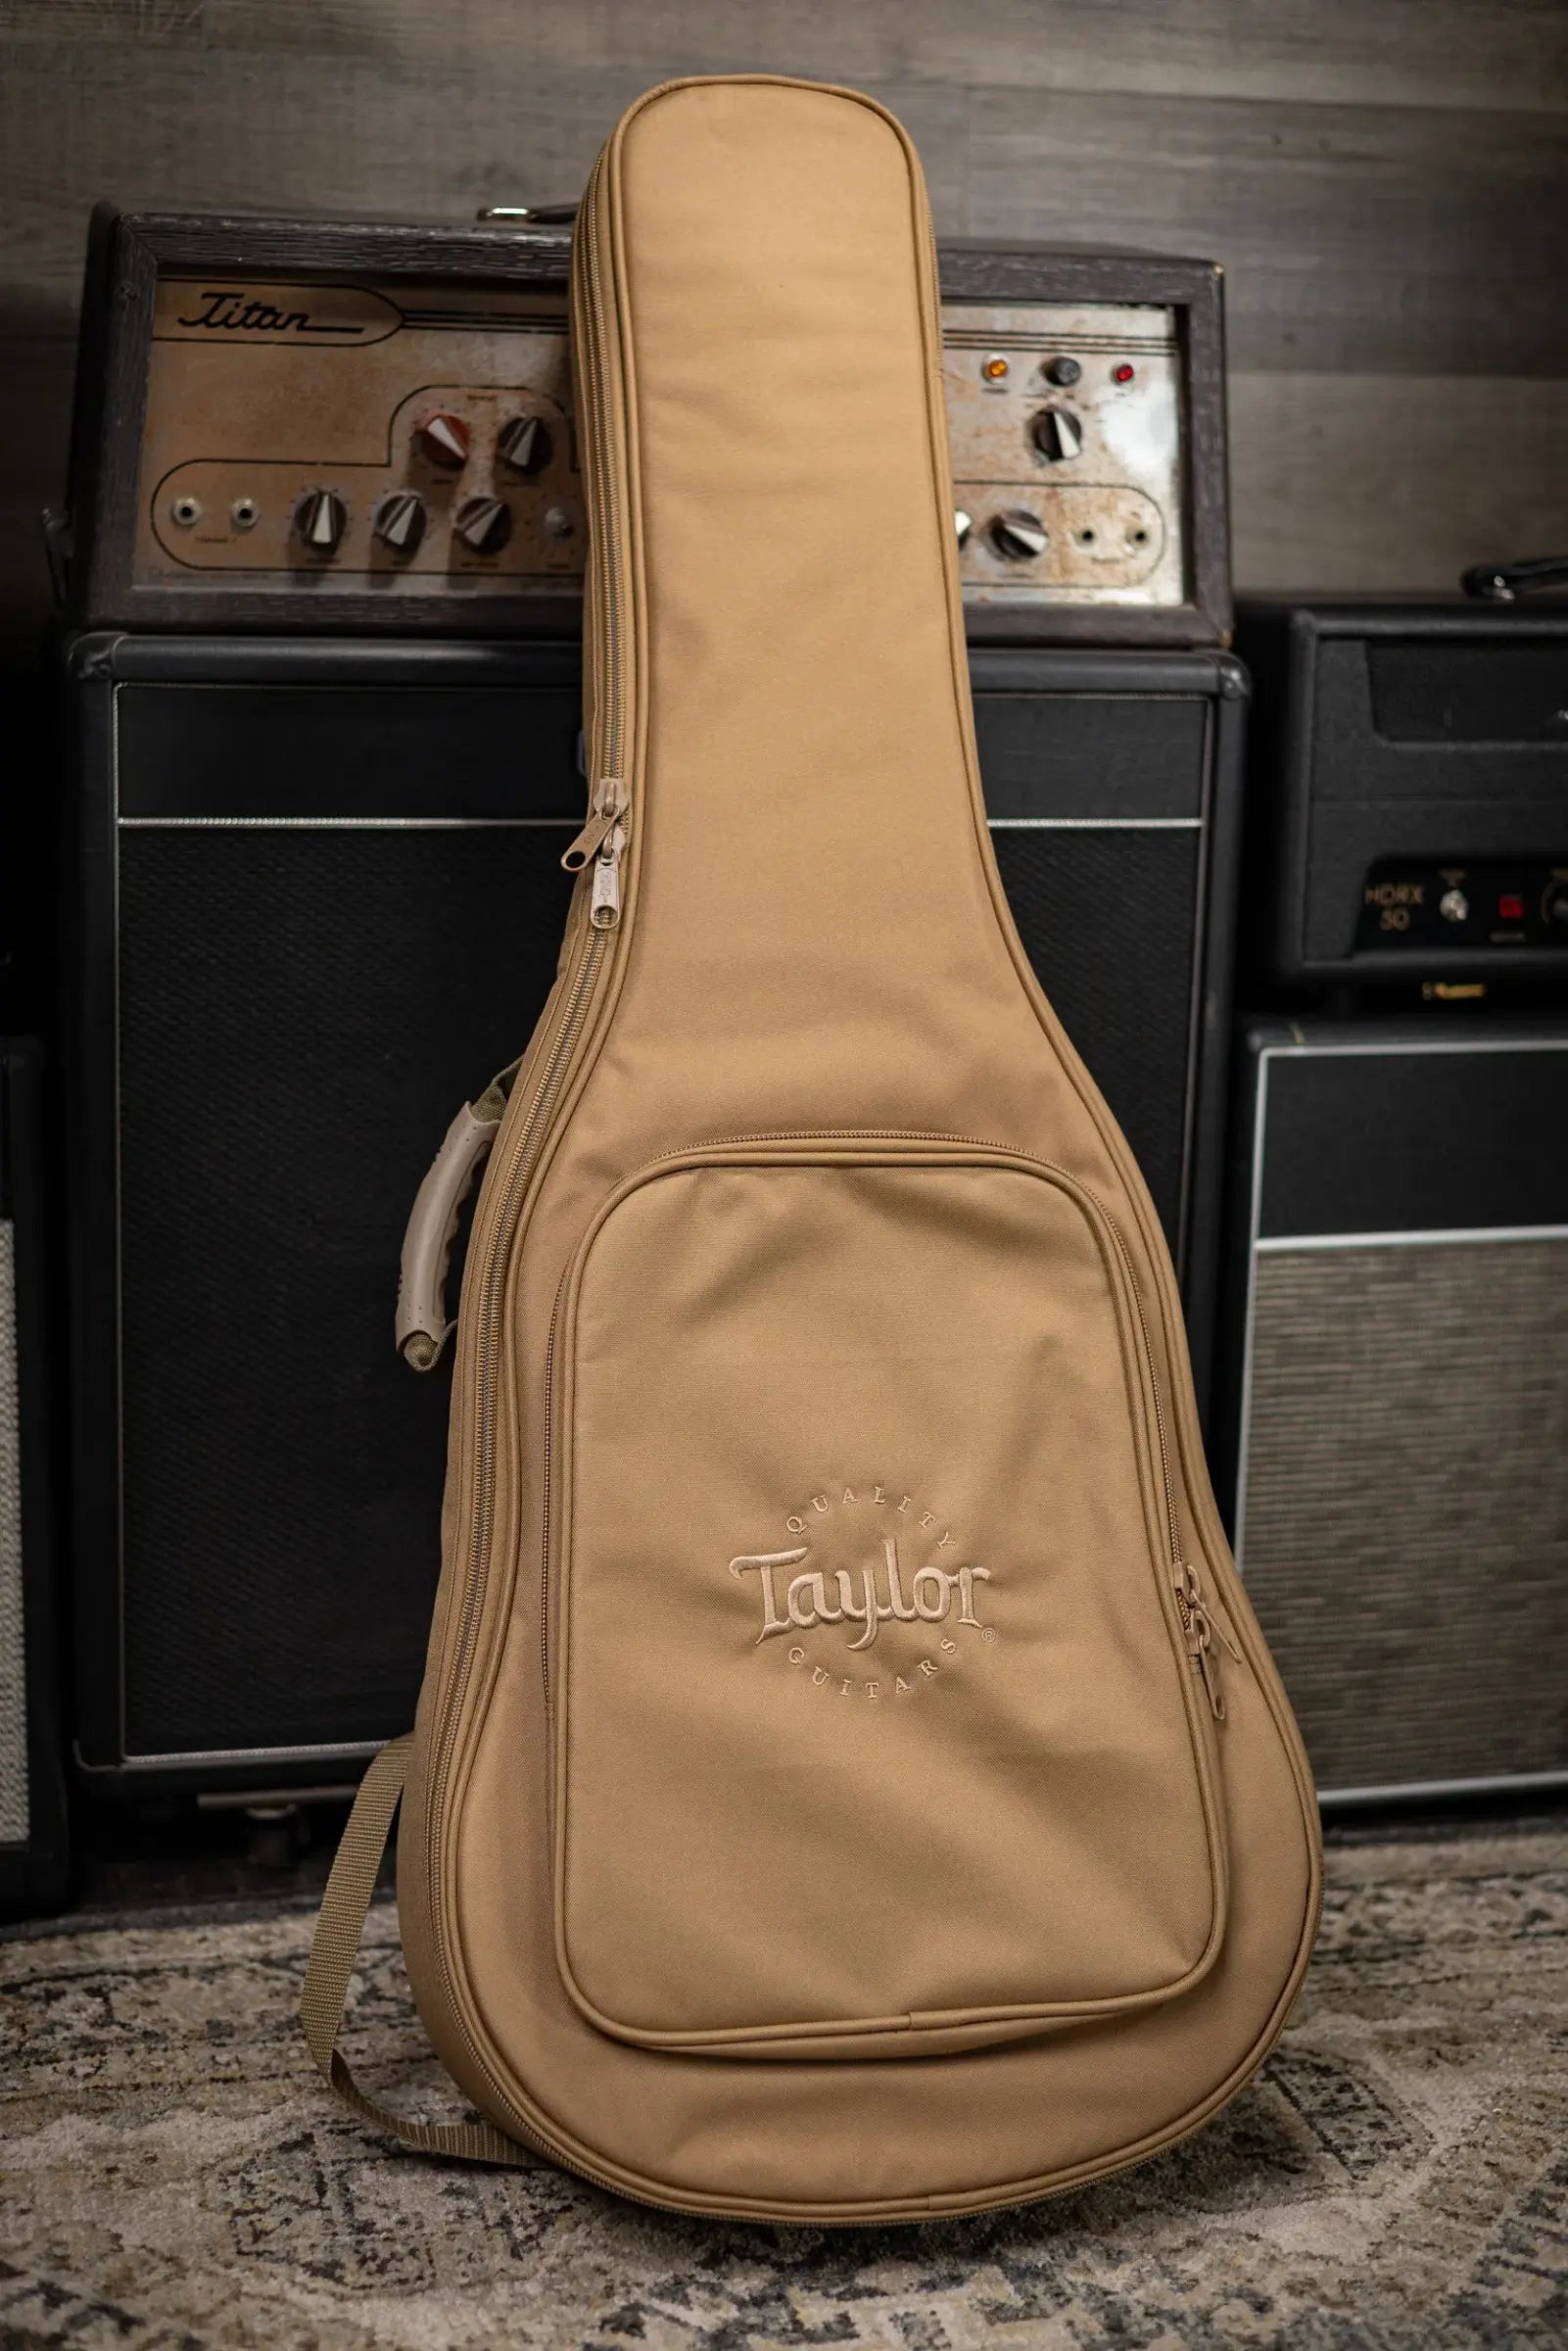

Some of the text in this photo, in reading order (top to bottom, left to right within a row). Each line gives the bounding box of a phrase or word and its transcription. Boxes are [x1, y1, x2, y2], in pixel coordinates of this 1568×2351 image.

[177, 292, 364, 334] Titan
[785, 1486, 956, 1550] QUALITY
[729, 1539, 991, 1651] Taylor
[787, 1639, 957, 1700] GUITARS
